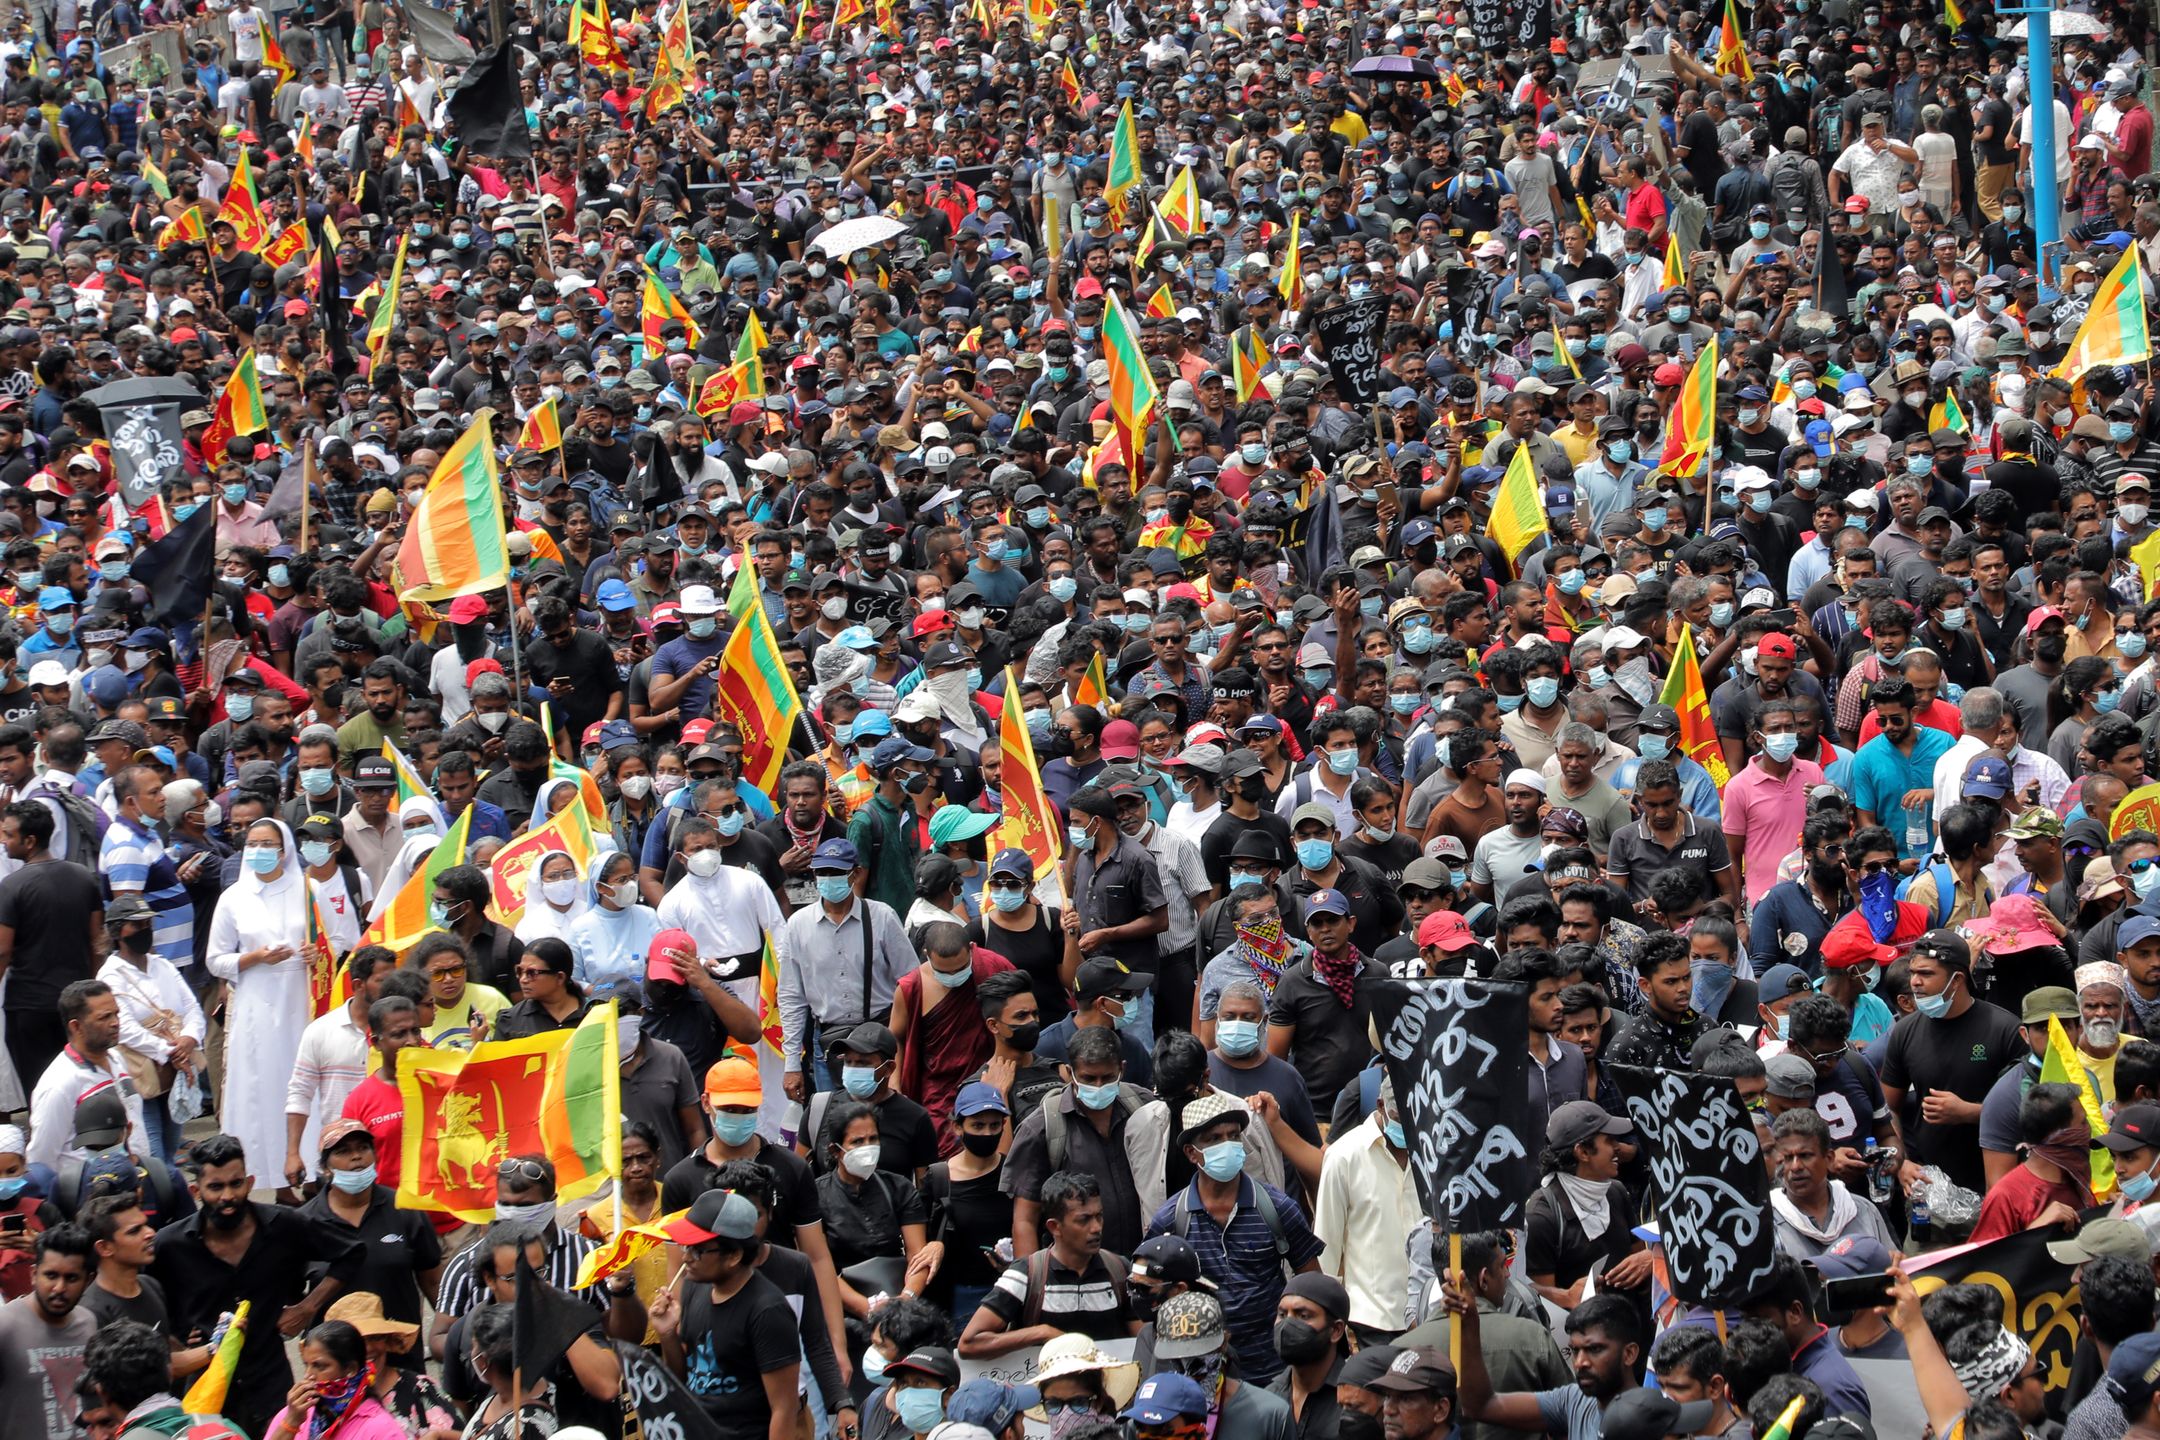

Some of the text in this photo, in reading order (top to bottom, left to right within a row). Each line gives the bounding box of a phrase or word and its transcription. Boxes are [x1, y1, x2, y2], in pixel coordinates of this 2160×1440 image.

[1213, 688, 1227, 698] GO
[1431, 843, 1455, 852] QATAR
[1681, 848, 1708, 860] PUMA
[1564, 866, 1589, 879] GOTA
[370, 1111, 403, 1124] TOMMY
[1815, 1090, 1858, 1142] 9
[1144, 1411, 1163, 1421] FILA
